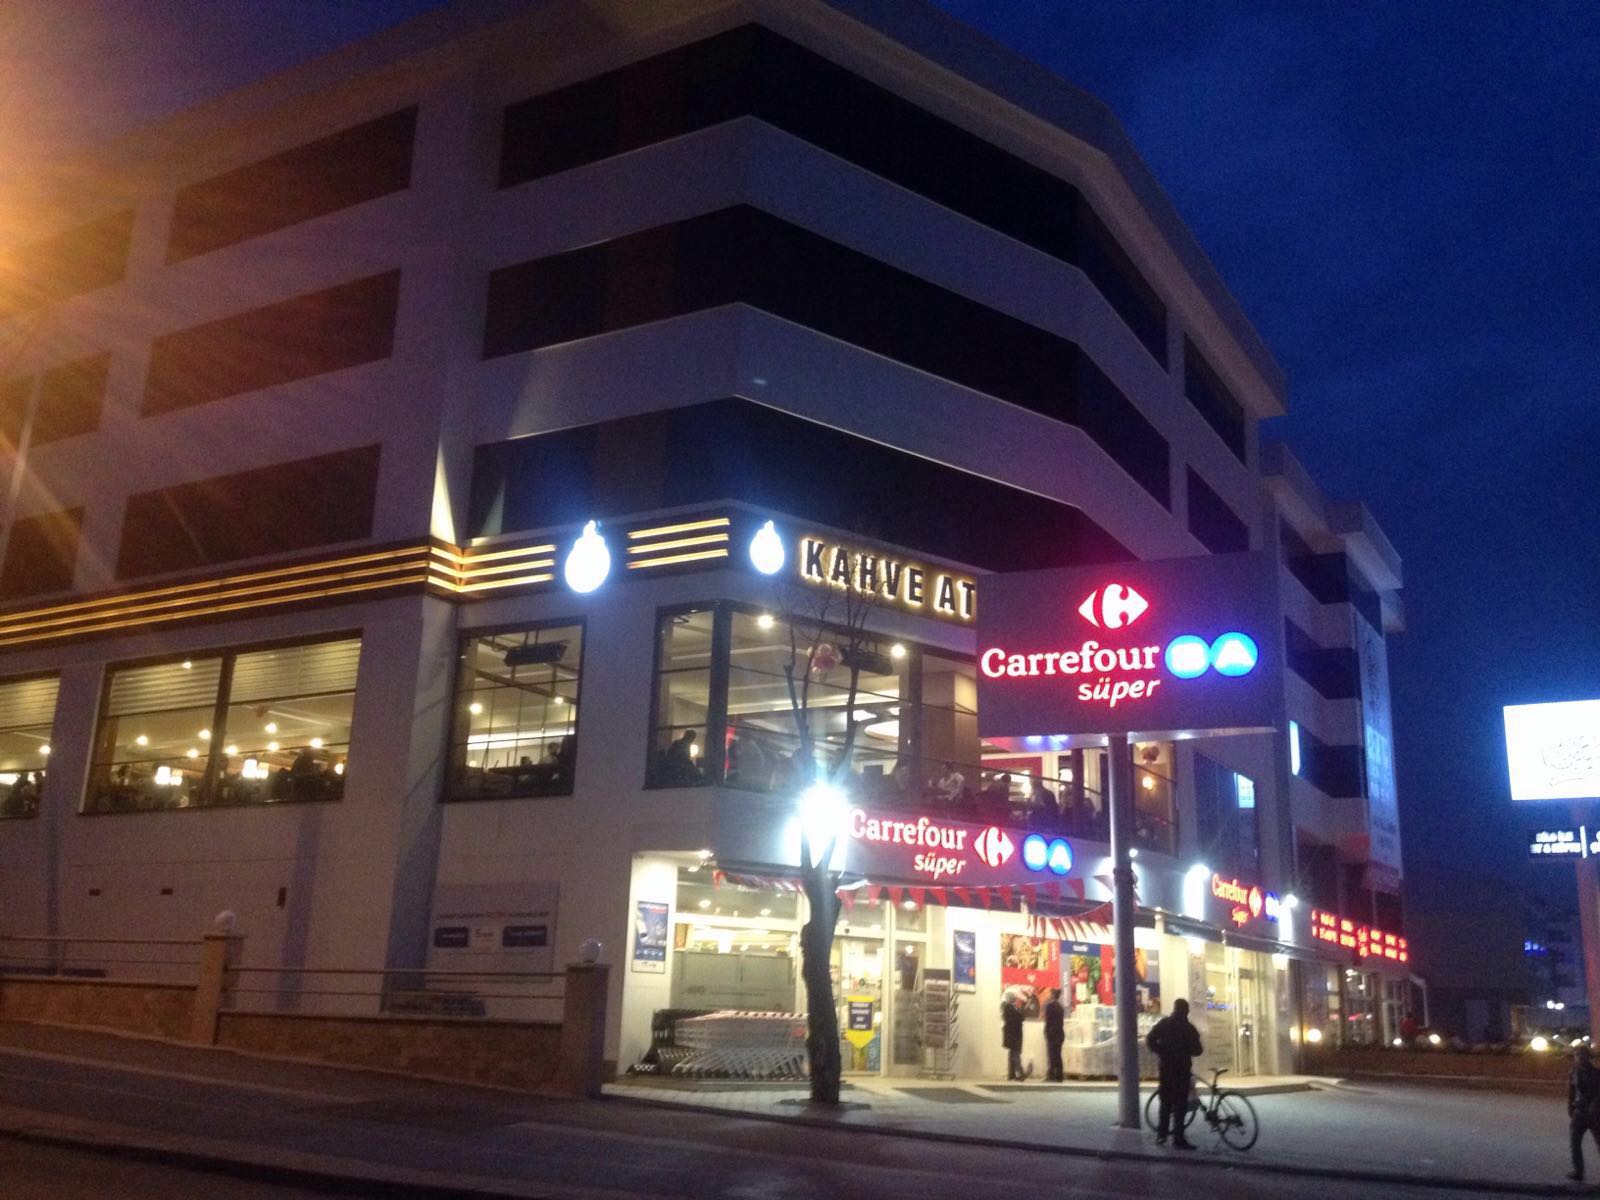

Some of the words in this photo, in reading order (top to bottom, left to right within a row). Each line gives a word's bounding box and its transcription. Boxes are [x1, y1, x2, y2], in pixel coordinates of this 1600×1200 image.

[802, 539, 923, 606] KAHVE
[981, 640, 1160, 677] Carrefour
[1078, 677, 1160, 708] süper
[849, 808, 967, 851] Carrefour
[914, 851, 967, 880] süper
[1212, 873, 1248, 906] Carrefour
